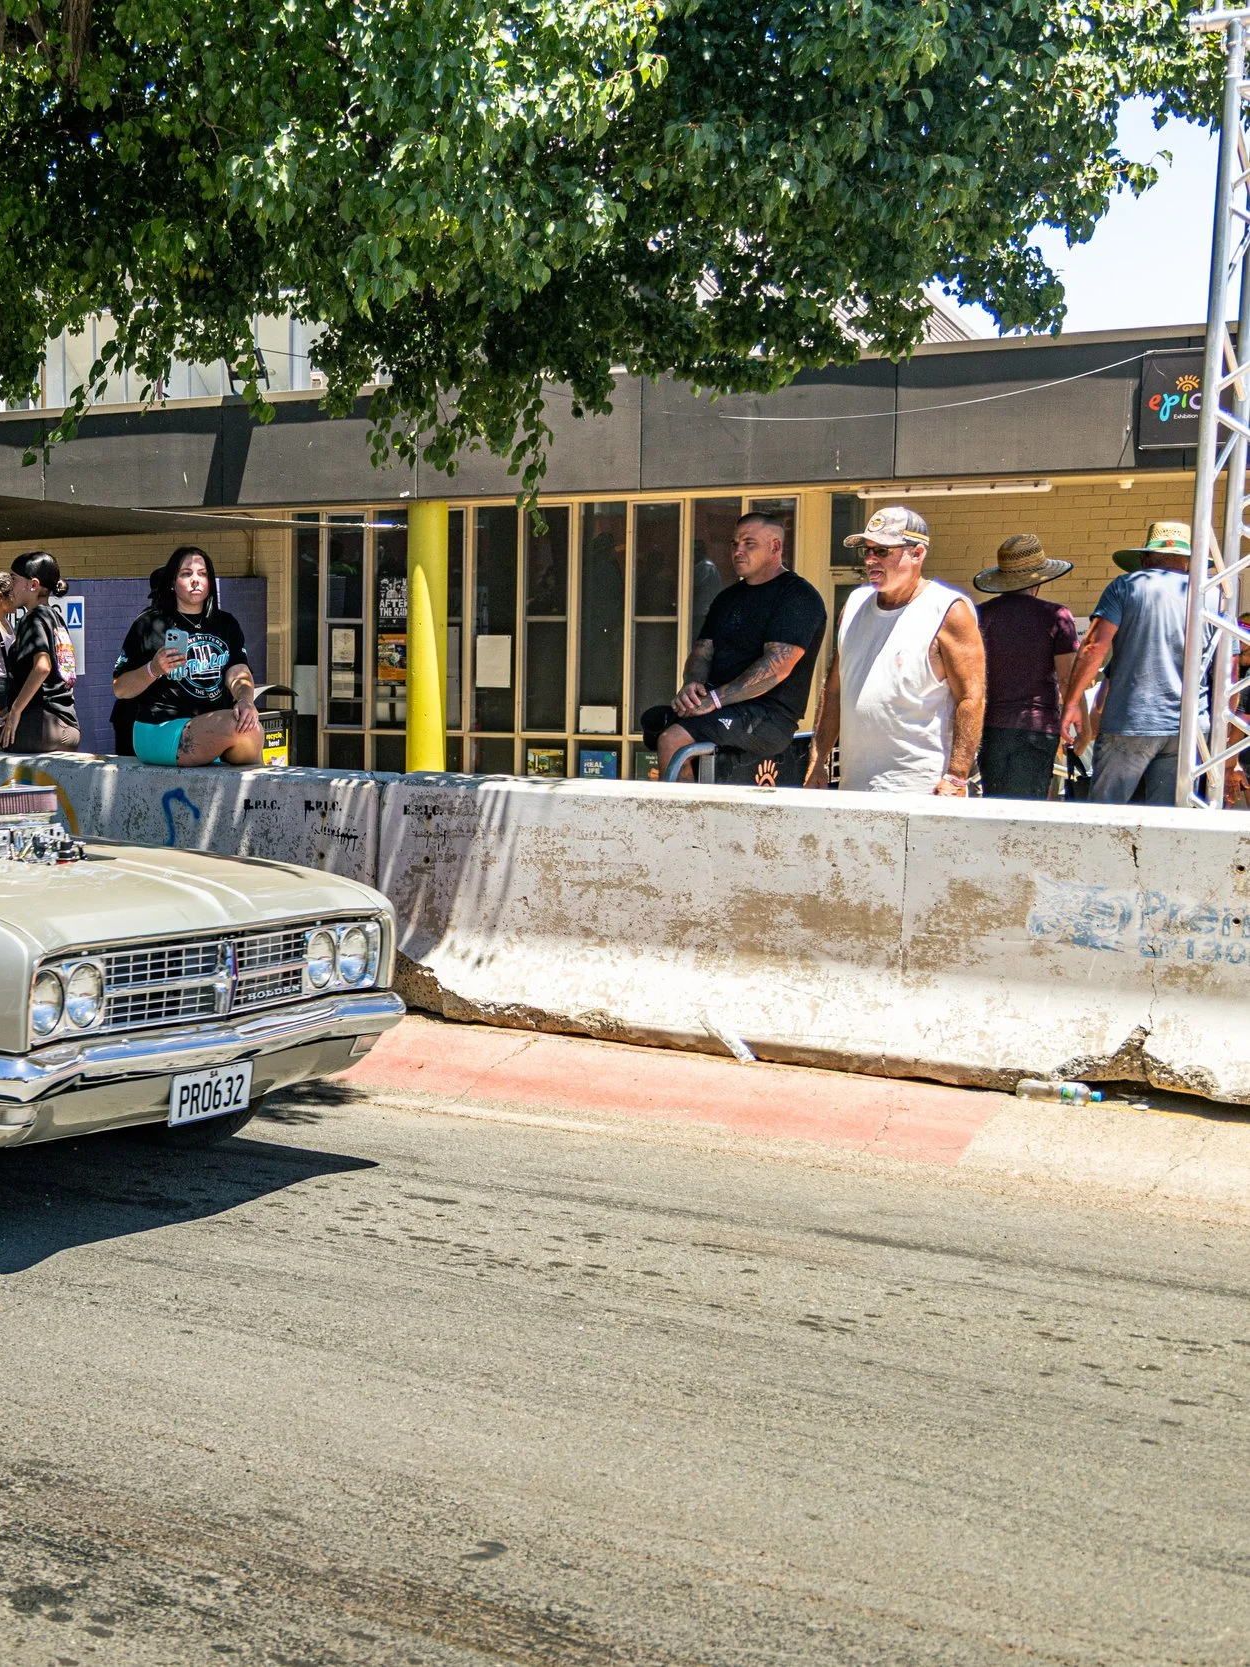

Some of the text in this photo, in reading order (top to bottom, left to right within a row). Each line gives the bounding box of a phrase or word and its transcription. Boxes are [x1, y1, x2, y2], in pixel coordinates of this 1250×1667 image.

[1149, 392, 1203, 421] epic
[379, 607, 392, 616] THE
[247, 984, 301, 1001] HOLDEN
[210, 1070, 218, 1078] SA
